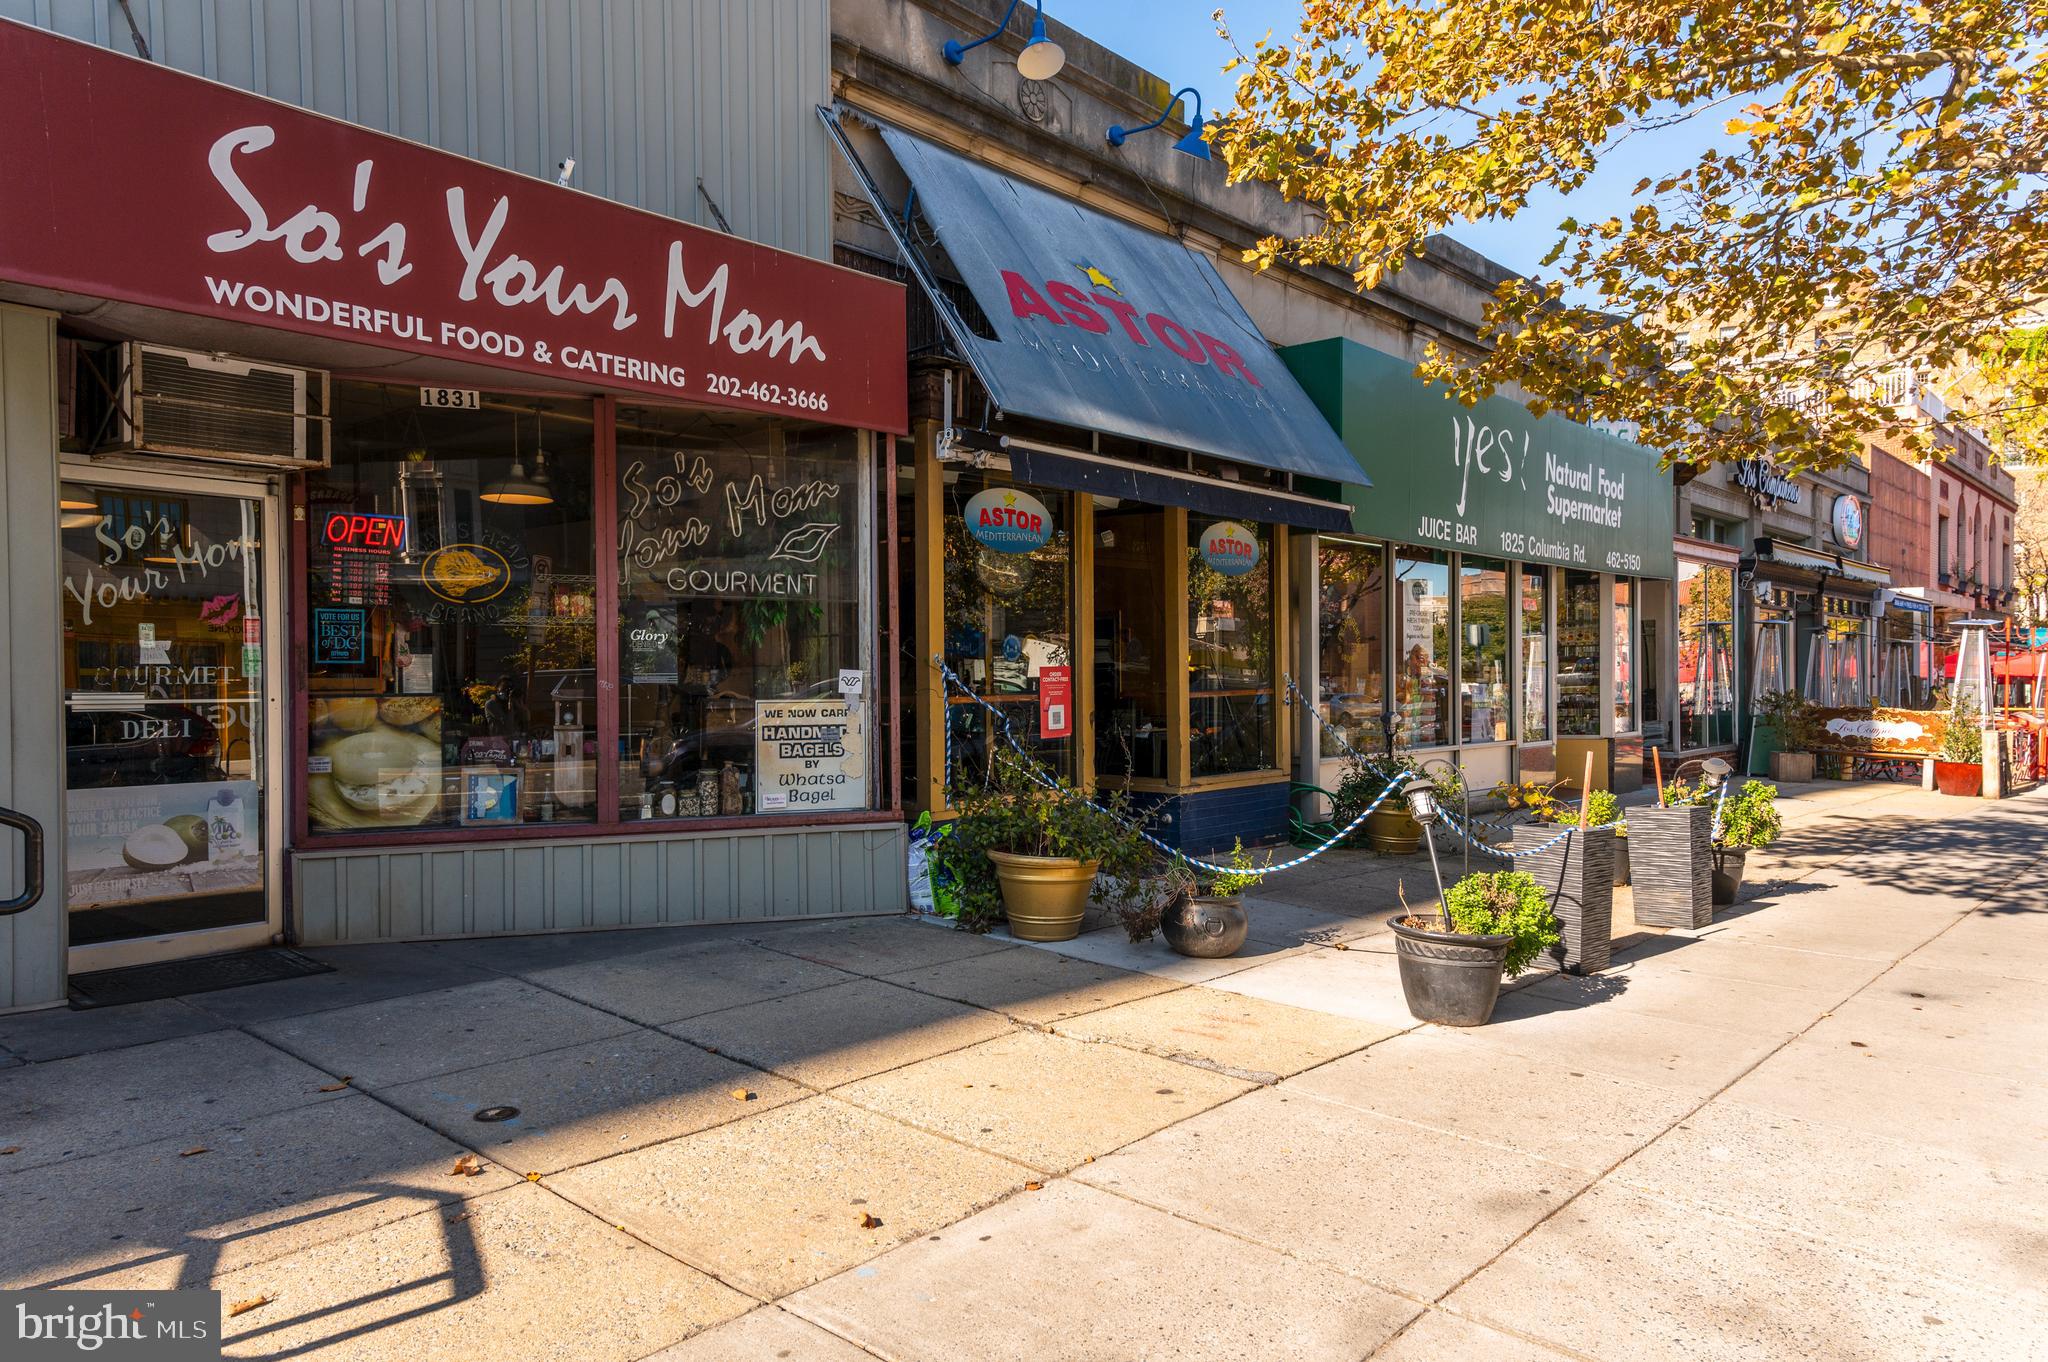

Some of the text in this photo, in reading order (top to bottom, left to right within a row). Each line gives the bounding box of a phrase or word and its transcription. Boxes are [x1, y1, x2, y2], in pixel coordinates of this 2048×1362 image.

[206, 125, 827, 364] So's Your Mom
[1001, 269, 1264, 388] ASTOR
[205, 276, 829, 412] WONDERFUL FOOD & CATERING 202-462-3666
[422, 388, 479, 409] 1831
[622, 451, 713, 520] So's
[1545, 451, 1625, 500] Natural Food
[726, 474, 841, 538] Mom
[1547, 486, 1622, 528] Supermarket
[327, 515, 404, 547] OPEN
[979, 507, 1042, 535] ASTOR
[95, 510, 176, 568] So's
[975, 529, 1044, 543] MEDITERRANEAN
[1418, 516, 1641, 572] JUICE BAR 1825 Columbia Rd. 462-5150
[1210, 538, 1253, 560] ASTOR
[667, 568, 817, 595] GOURMENT
[63, 567, 169, 626] Your
[320, 624, 360, 637] BEST
[630, 629, 669, 644] Glory
[94, 665, 234, 687] GOURMET
[764, 709, 784, 719] WE
[788, 708, 817, 719] NOW
[120, 718, 192, 740] DELI
[779, 742, 845, 759] BAGELS
[805, 760, 820, 769] BY
[778, 773, 846, 787] Whatsa
[789, 788, 836, 804] Bagel
[119, 806, 162, 820] PRACTICE
[66, 822, 97, 837] YOUR
[68, 882, 94, 898] JUST
